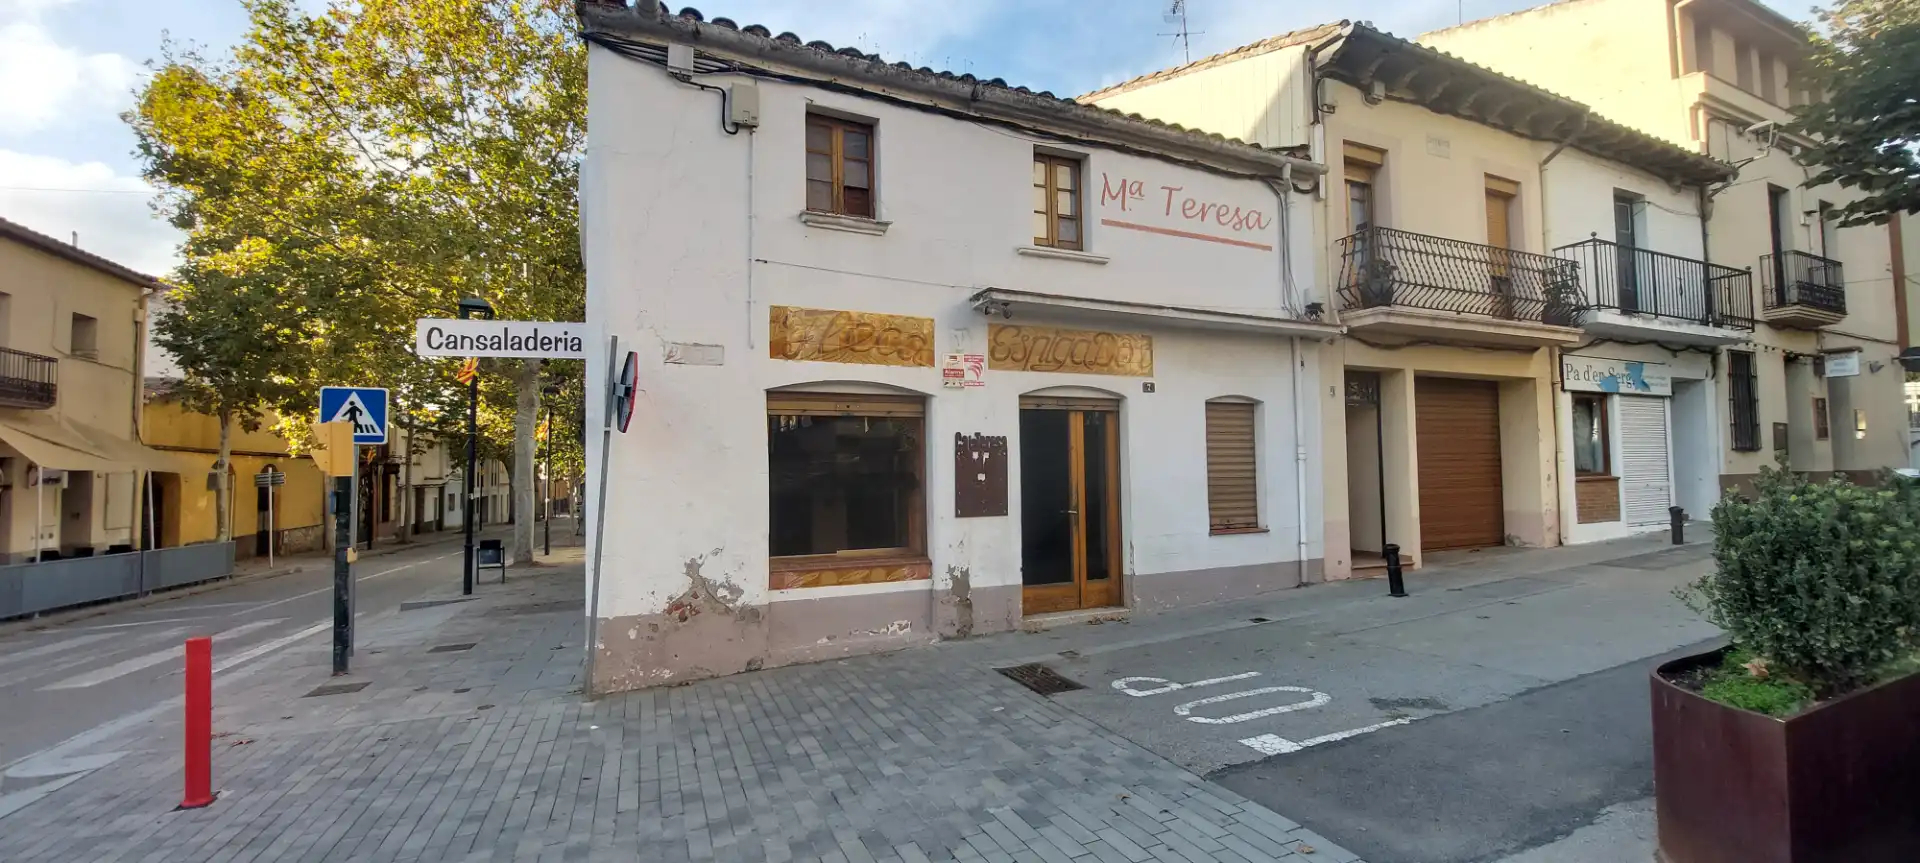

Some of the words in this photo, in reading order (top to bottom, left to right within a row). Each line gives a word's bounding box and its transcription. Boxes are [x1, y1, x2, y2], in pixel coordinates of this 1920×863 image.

[1160, 186, 1271, 231] Teresa
[426, 326, 582, 352] Cansaladeria
[1565, 363, 1580, 381] Pa
[1583, 365, 1605, 382] d'en
[1608, 366, 1635, 388] Serg
